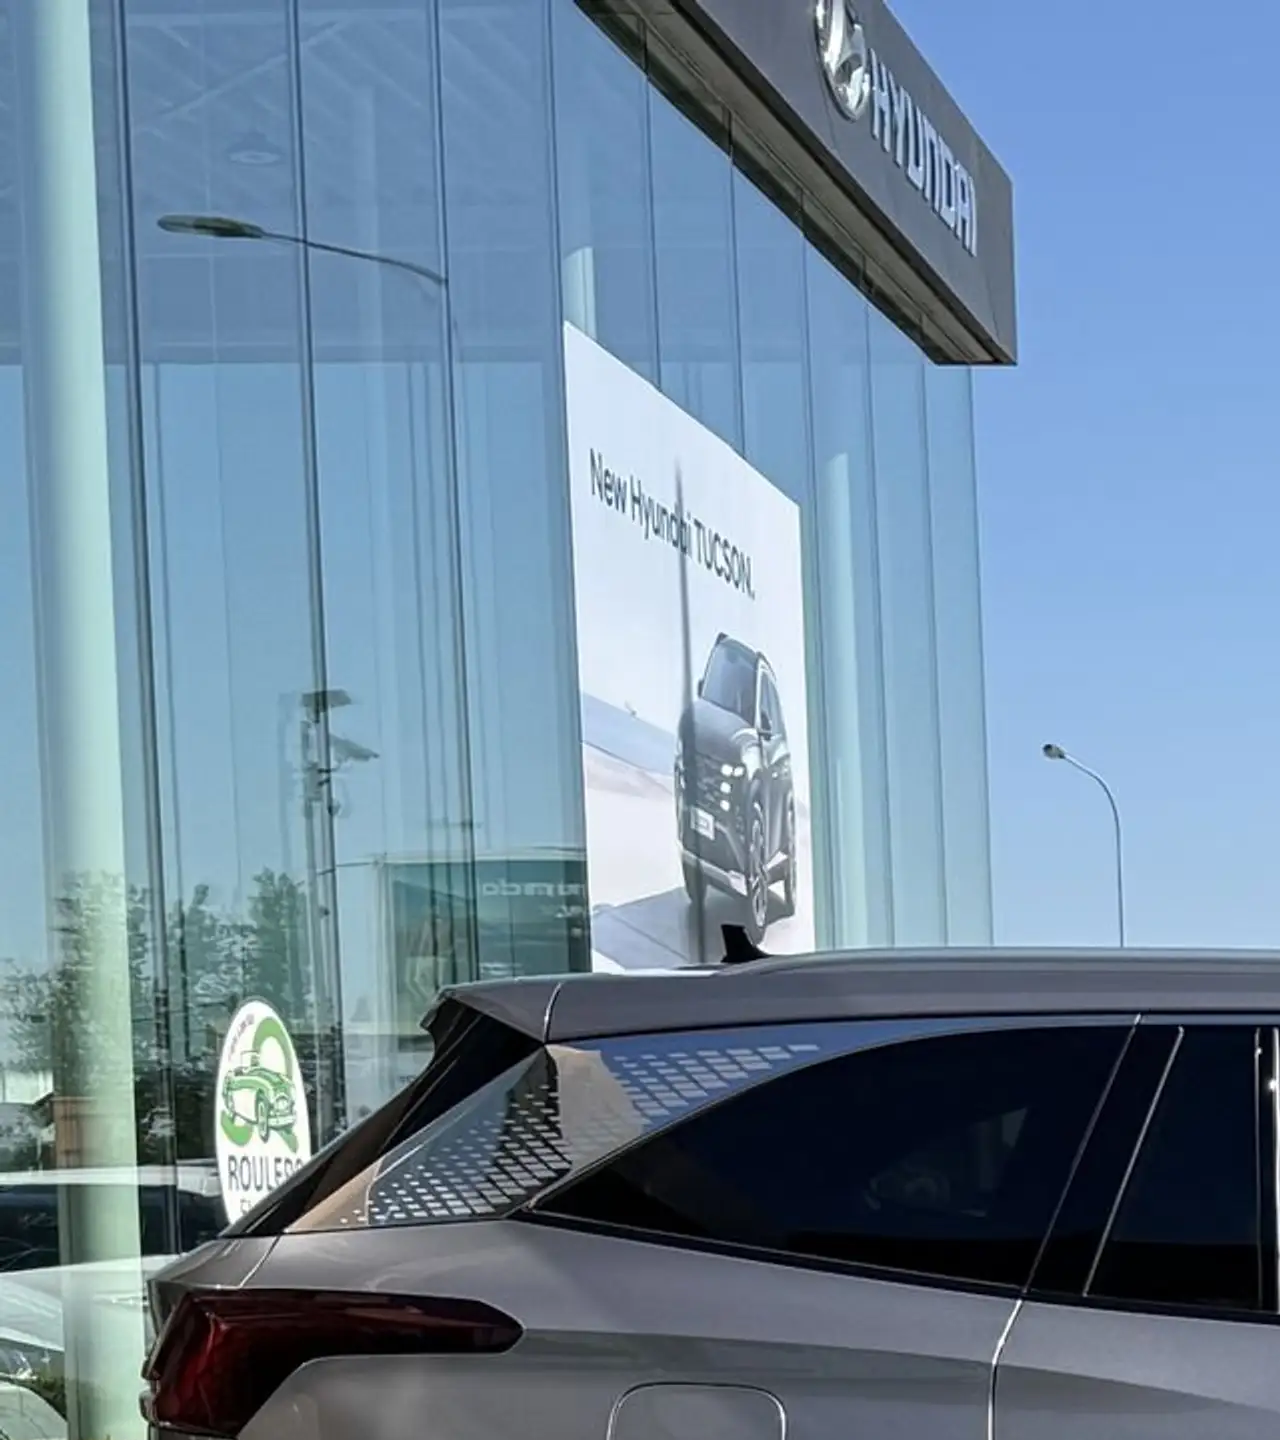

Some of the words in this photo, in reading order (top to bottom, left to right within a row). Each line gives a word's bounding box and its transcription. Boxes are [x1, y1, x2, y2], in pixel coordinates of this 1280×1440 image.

[868, 48, 978, 258] HYUNDAI
[589, 448, 628, 514] New
[693, 517, 756, 601] TUCSON.
